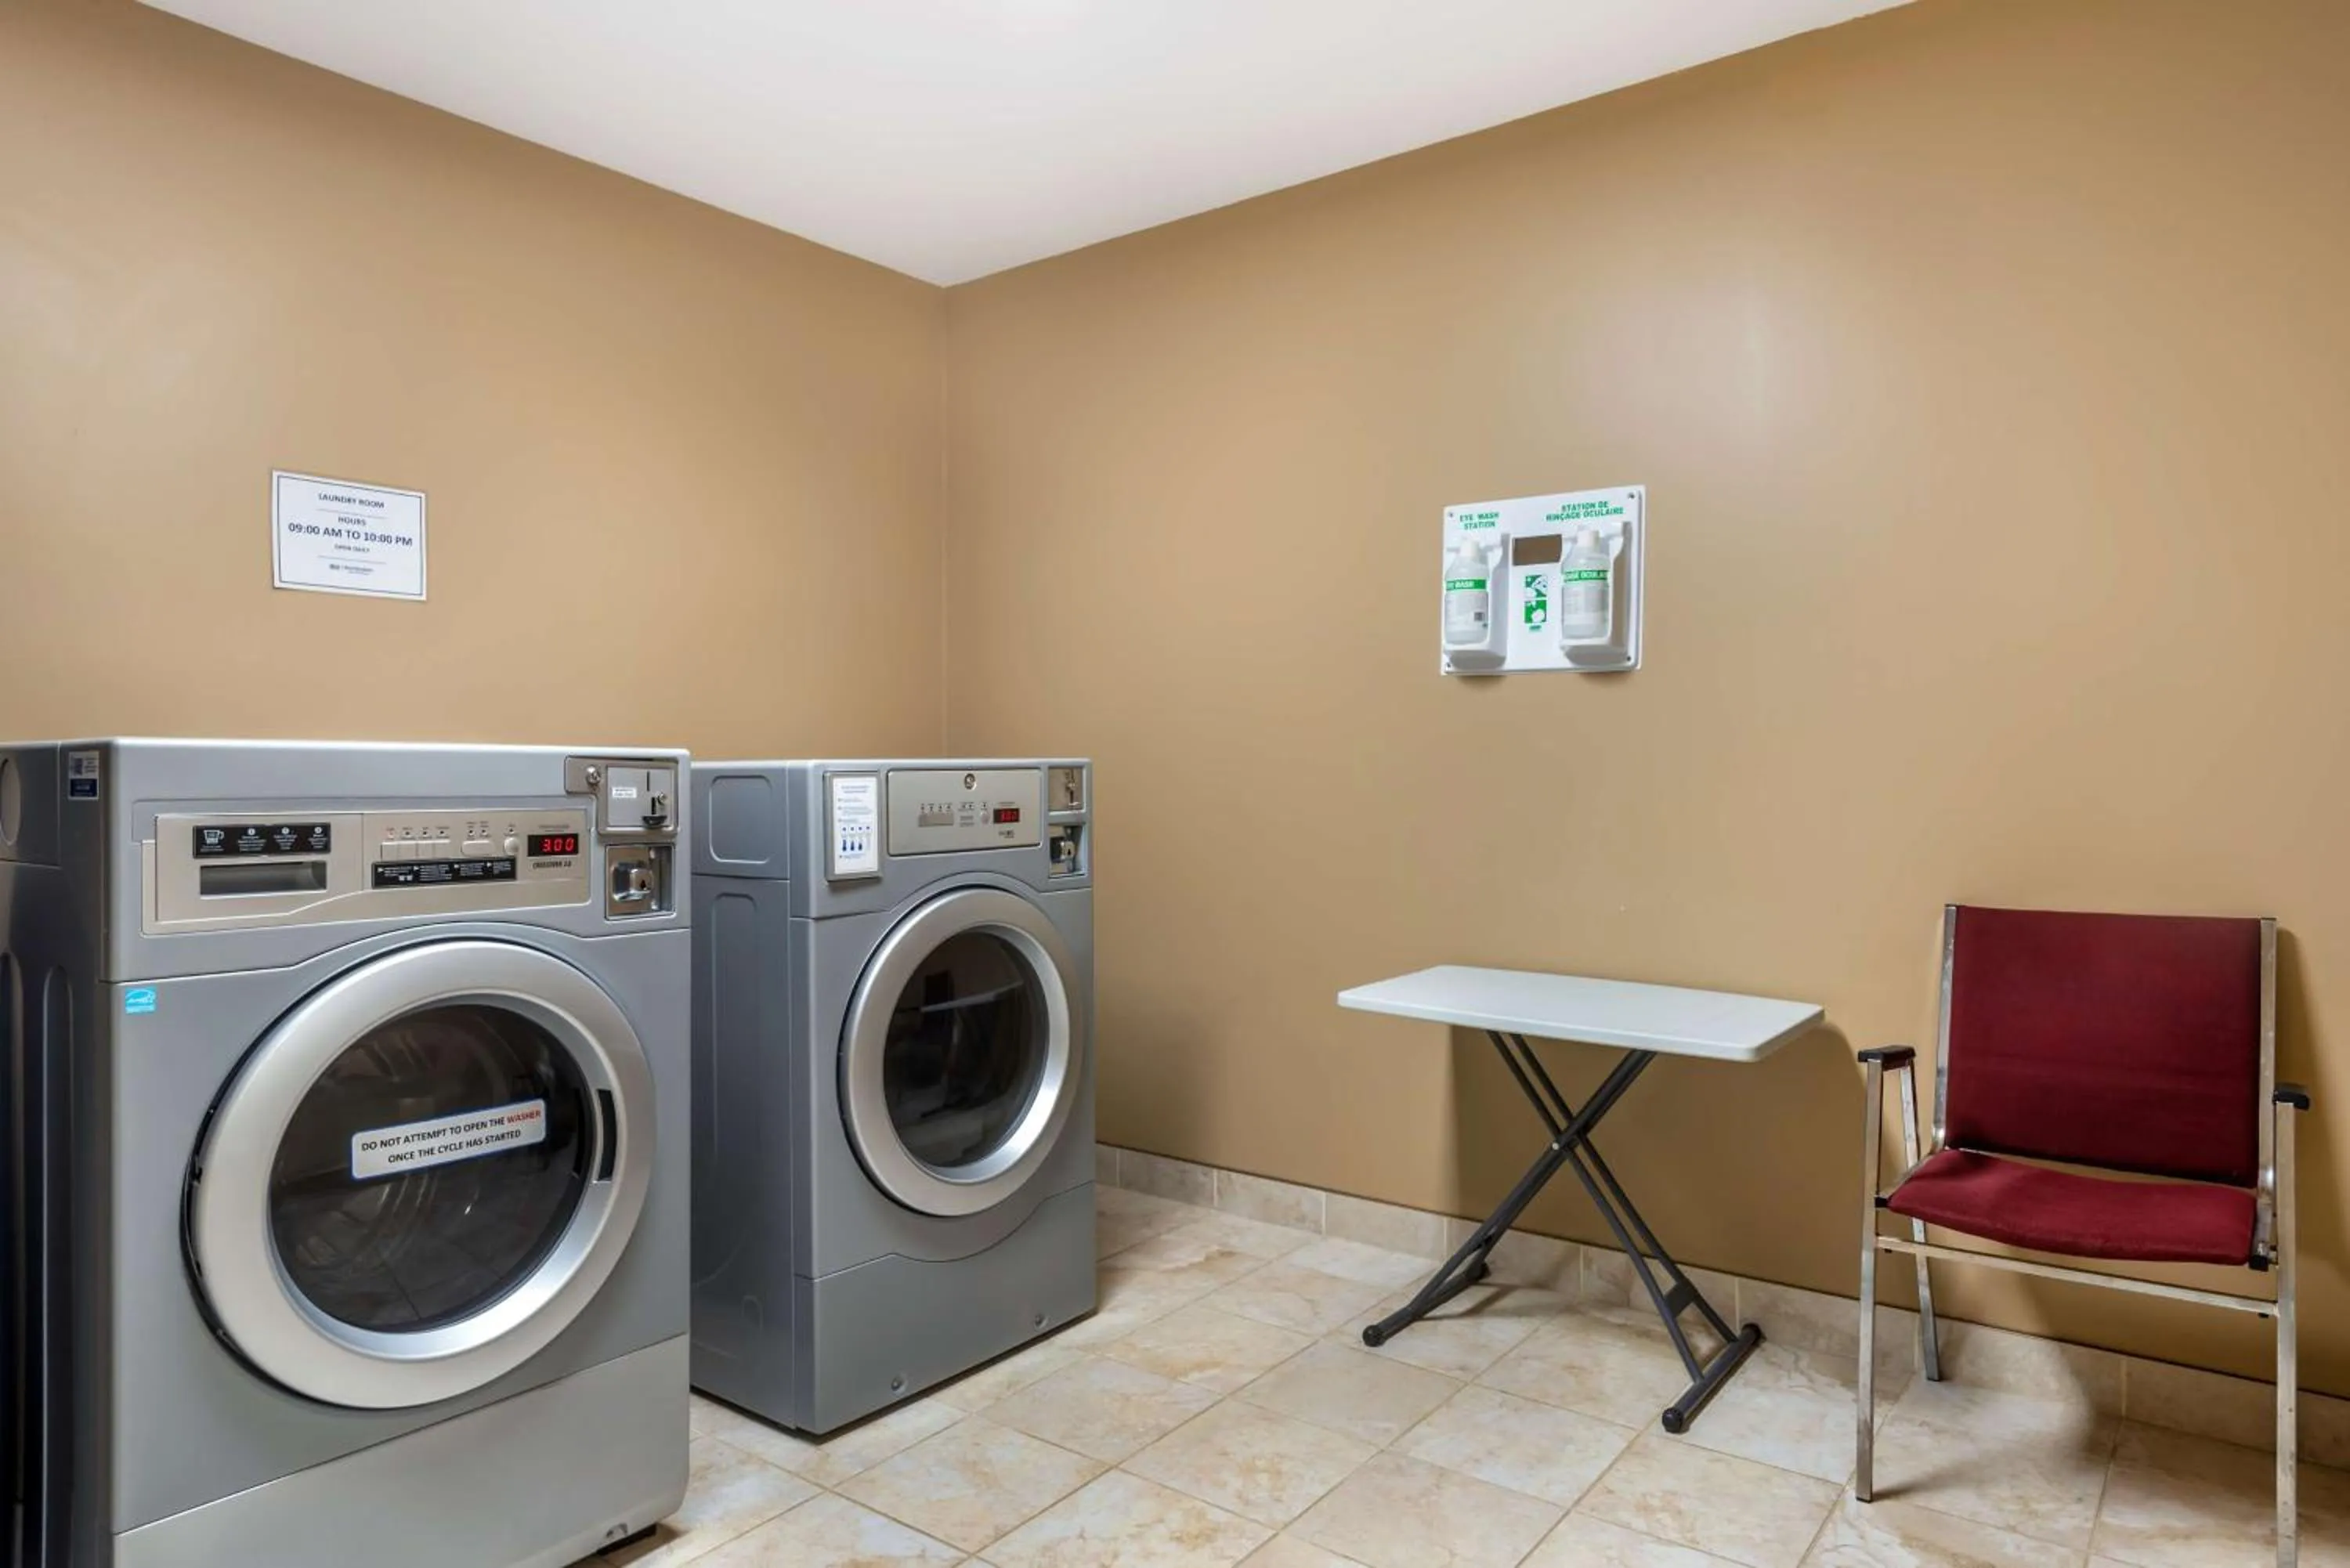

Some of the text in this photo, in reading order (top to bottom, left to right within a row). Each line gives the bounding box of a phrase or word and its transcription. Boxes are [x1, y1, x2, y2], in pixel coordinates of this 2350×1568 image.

[318, 493, 385, 508] LAUNDRY ROOM
[1561, 502, 1596, 511] STATION
[1459, 514, 1473, 522] EYE
[1583, 506, 1624, 518] OCULAIRE
[338, 516, 367, 526] HOURS
[1464, 521, 1495, 530] STATION
[288, 522, 413, 547] 09:00 AM TO 10:00 PM
[361, 1109, 542, 1152] DO NOT ATTEMPT TO OPEN THE WASHER
[388, 1129, 521, 1164] ONCE THE CYCLE HAS STARTED
